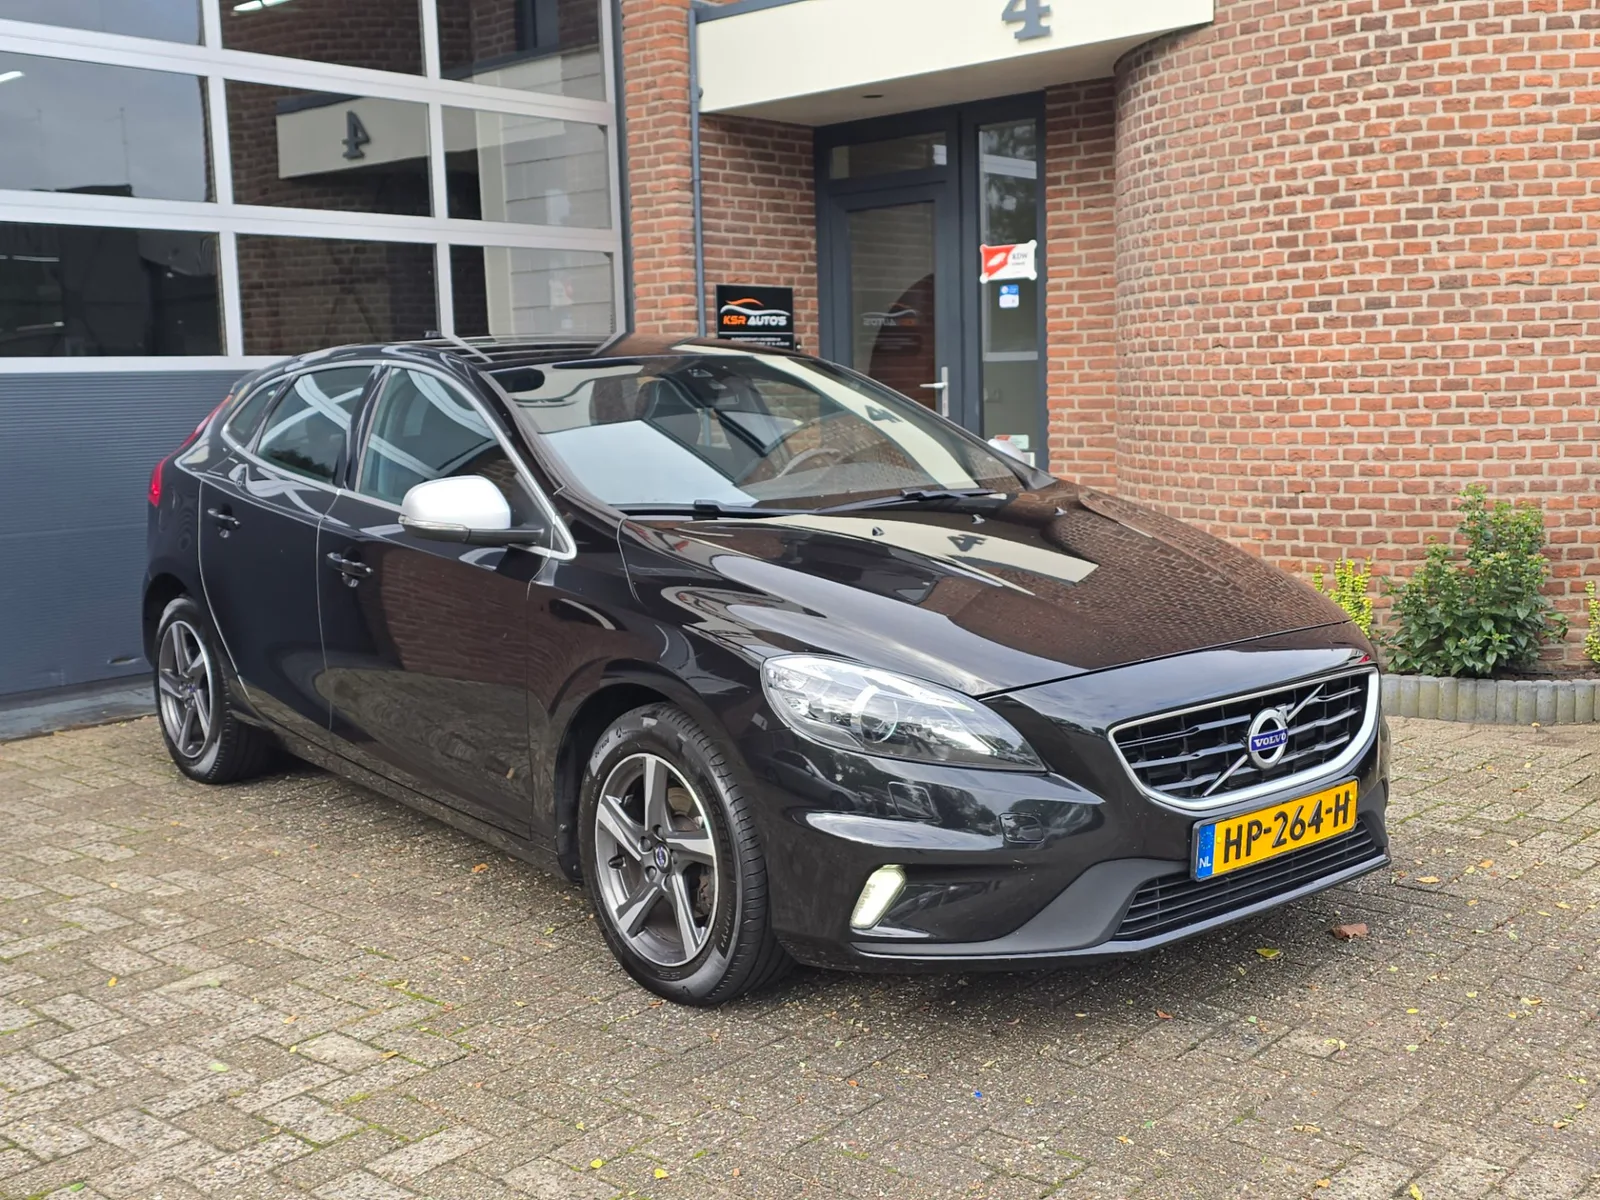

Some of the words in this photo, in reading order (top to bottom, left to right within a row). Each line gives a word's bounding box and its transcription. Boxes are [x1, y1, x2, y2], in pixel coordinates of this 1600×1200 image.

[1002, 0, 1051, 40] 4
[723, 315, 747, 325] KSR
[1253, 731, 1287, 747] VOLVO
[1223, 790, 1350, 864] HP-264-H
[1198, 856, 1211, 869] NL
